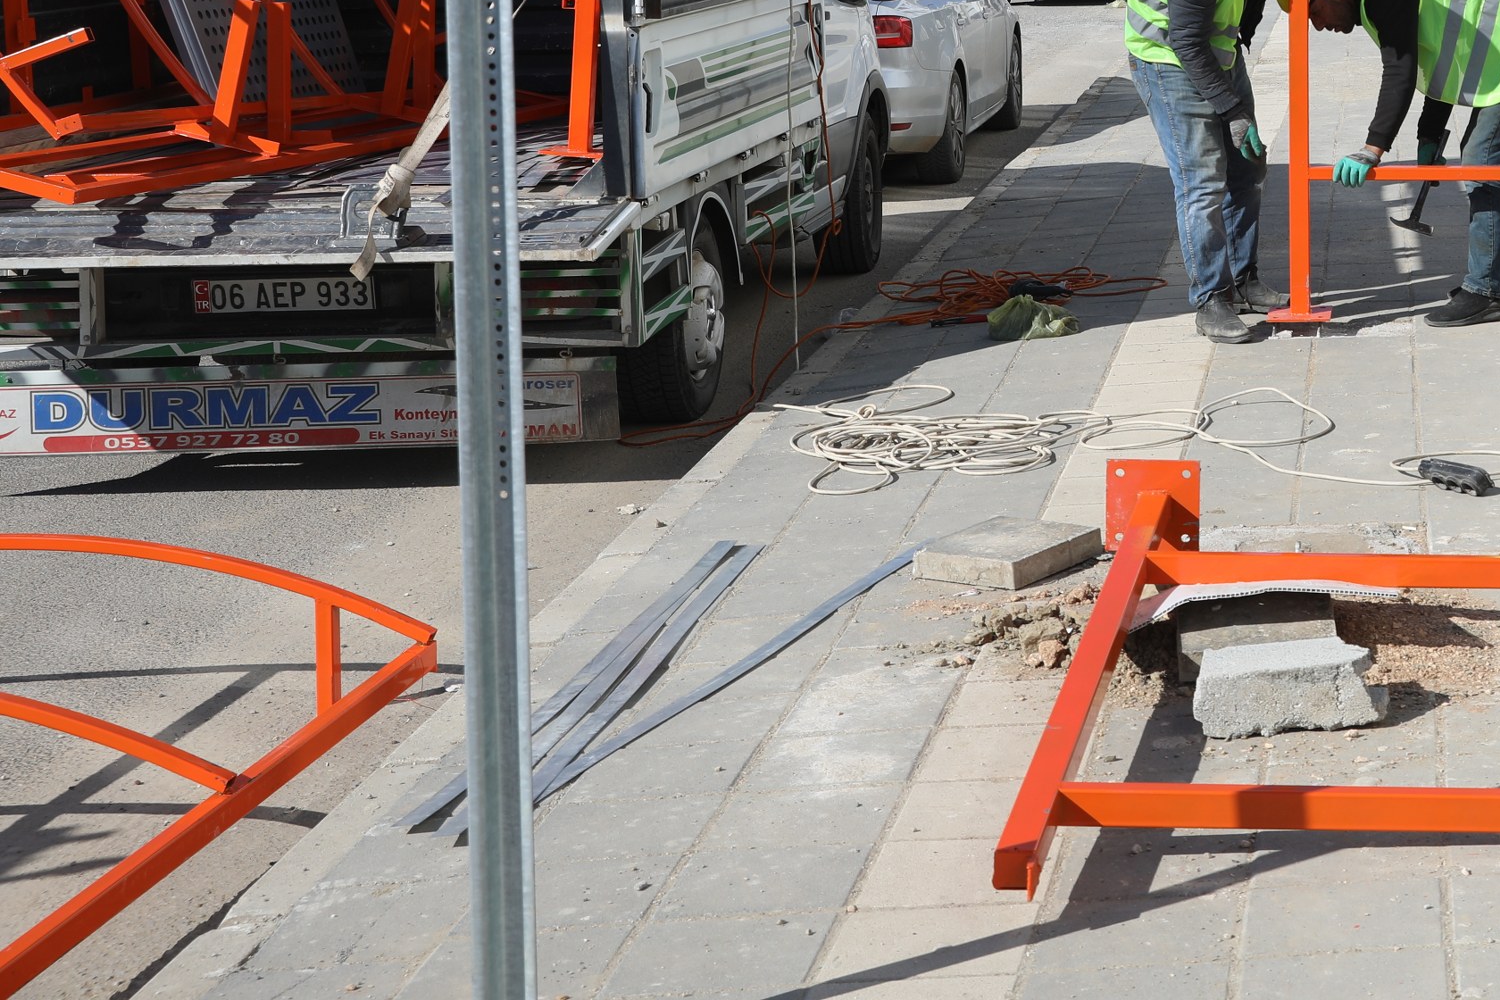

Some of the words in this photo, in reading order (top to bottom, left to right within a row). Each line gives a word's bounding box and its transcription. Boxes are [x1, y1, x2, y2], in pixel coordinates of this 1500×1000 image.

[212, 284, 245, 310] 06
[256, 281, 306, 308] AEP
[317, 281, 369, 307] 933
[196, 301, 209, 310] TR
[30, 382, 381, 434] DURMAZ
[369, 431, 385, 440] Ek
[390, 429, 436, 441] Sanayi
[524, 423, 577, 437] MAN
[104, 436, 168, 449] 0537
[176, 434, 222, 447] 927
[230, 434, 260, 446] 72
[268, 432, 299, 444] 80
